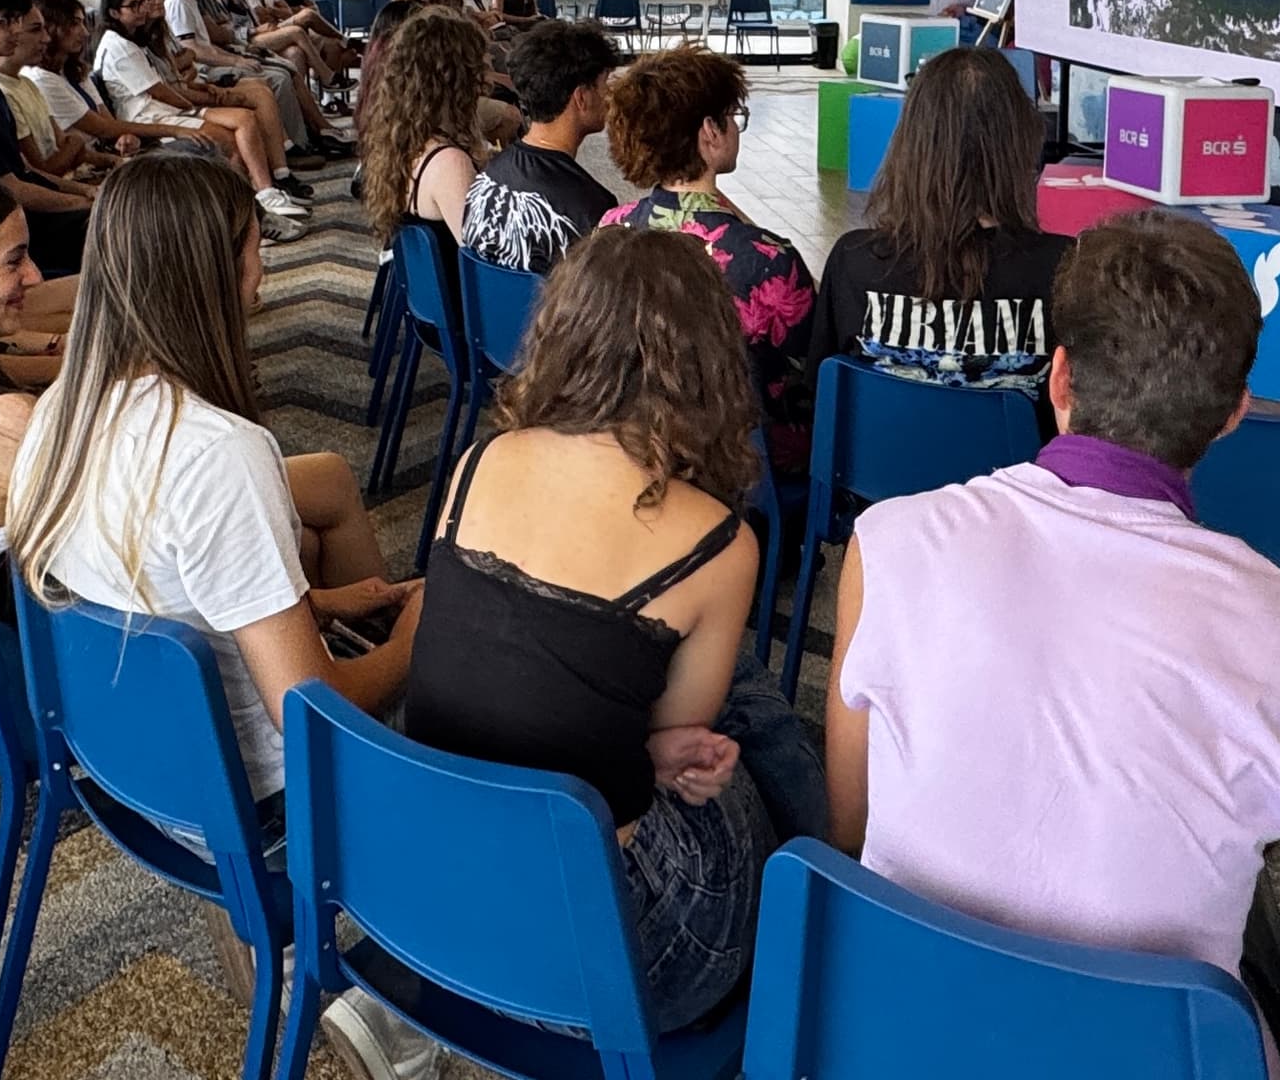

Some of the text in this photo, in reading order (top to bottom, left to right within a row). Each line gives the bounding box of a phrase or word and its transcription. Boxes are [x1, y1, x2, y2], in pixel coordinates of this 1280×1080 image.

[1119, 128, 1137, 146] BCR
[1202, 140, 1230, 155] BCR
[861, 290, 1048, 356] NIRVANA
